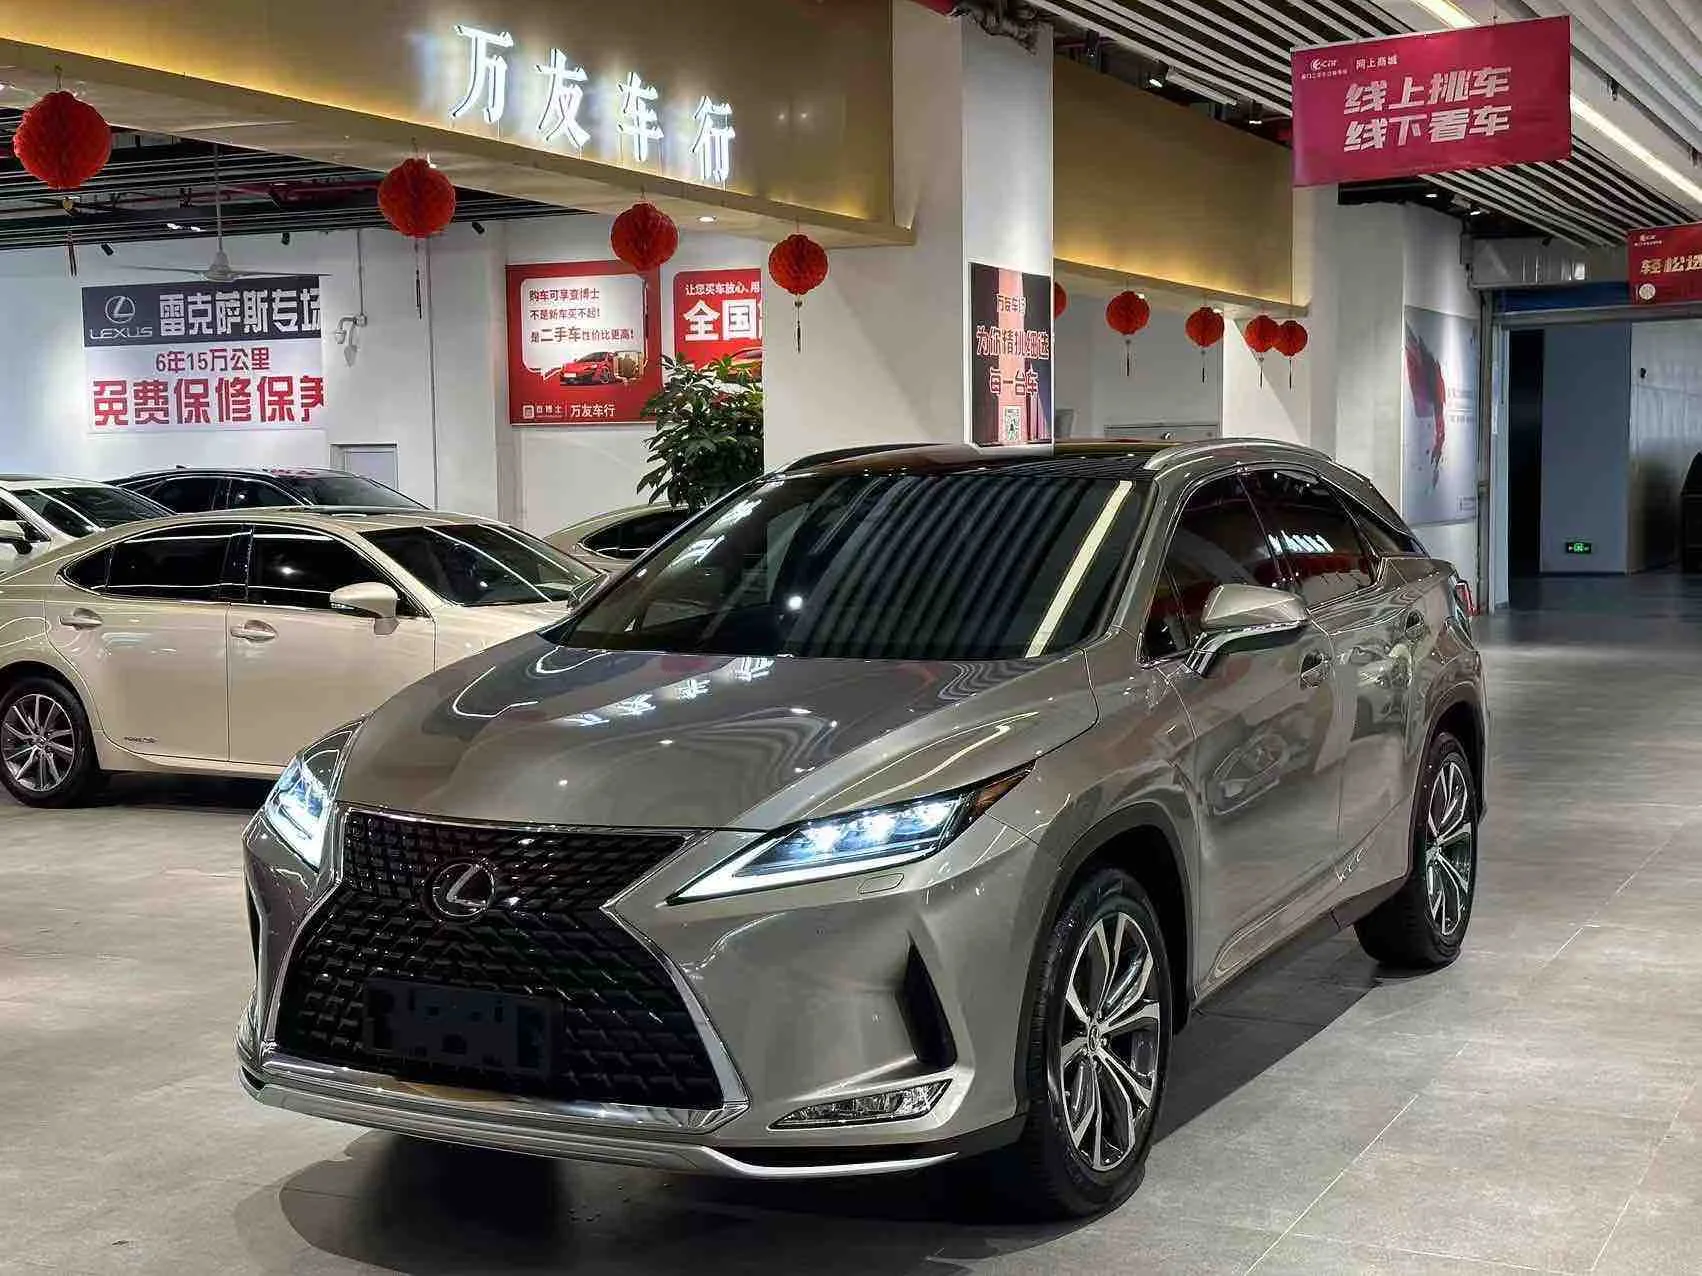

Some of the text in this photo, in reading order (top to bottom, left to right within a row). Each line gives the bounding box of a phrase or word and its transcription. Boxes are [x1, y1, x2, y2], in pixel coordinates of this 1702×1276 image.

[450, 24, 736, 183] 万友车行
[1344, 67, 1511, 114] 线上挑车
[1344, 105, 1511, 152] 线下看车
[529, 288, 600, 302] 购车可享查博士
[159, 288, 321, 336] 雷克萨斯专场
[529, 307, 600, 320] 不是新车买不起！
[683, 299, 762, 341] 全国
[89, 327, 153, 340] LEXUS
[976, 325, 1050, 360] 为你精挑细选
[156, 347, 270, 373] 6年15万公里
[989, 367, 1039, 396] 每一台车
[570, 404, 616, 418] 万友车行
